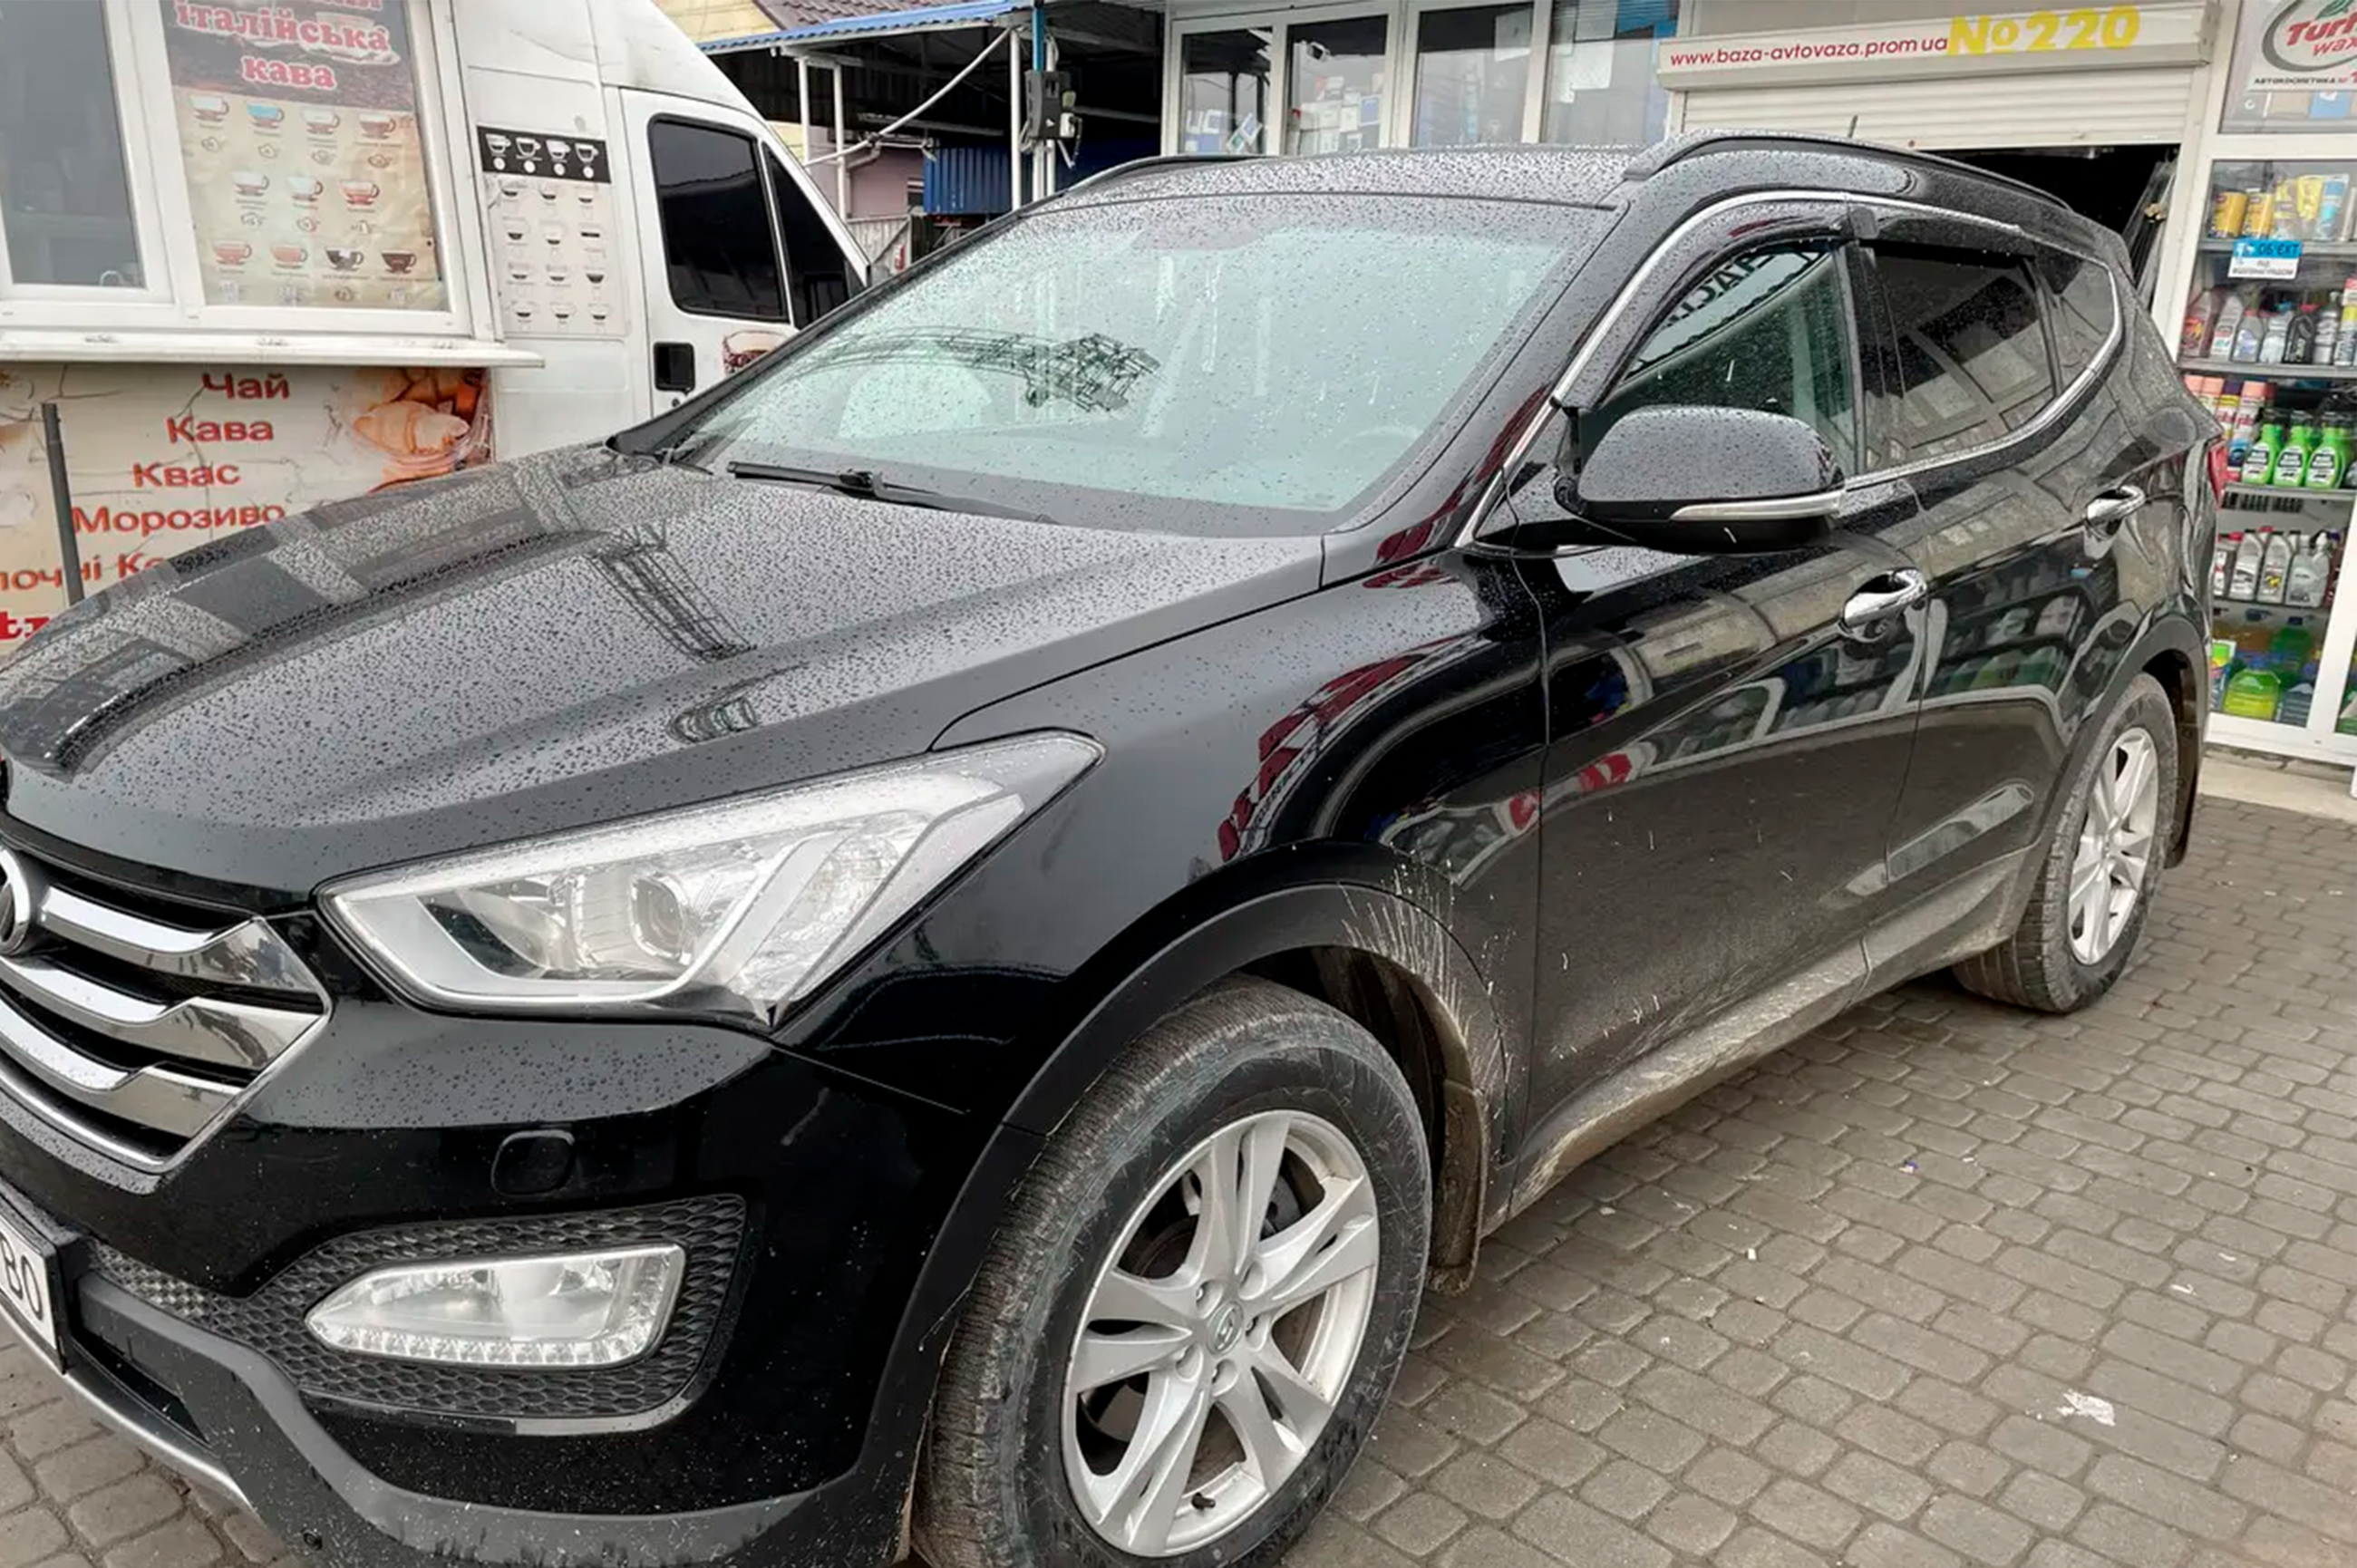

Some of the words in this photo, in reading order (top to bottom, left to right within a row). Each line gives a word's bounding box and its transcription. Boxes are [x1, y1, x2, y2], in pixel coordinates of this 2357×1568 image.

[175, 0, 393, 51] італійська
[243, 57, 336, 89] кава
[202, 373, 289, 399] Чай
[166, 415, 274, 443] Кава
[133, 462, 240, 487] Квас
[73, 504, 286, 537] Морозиво
